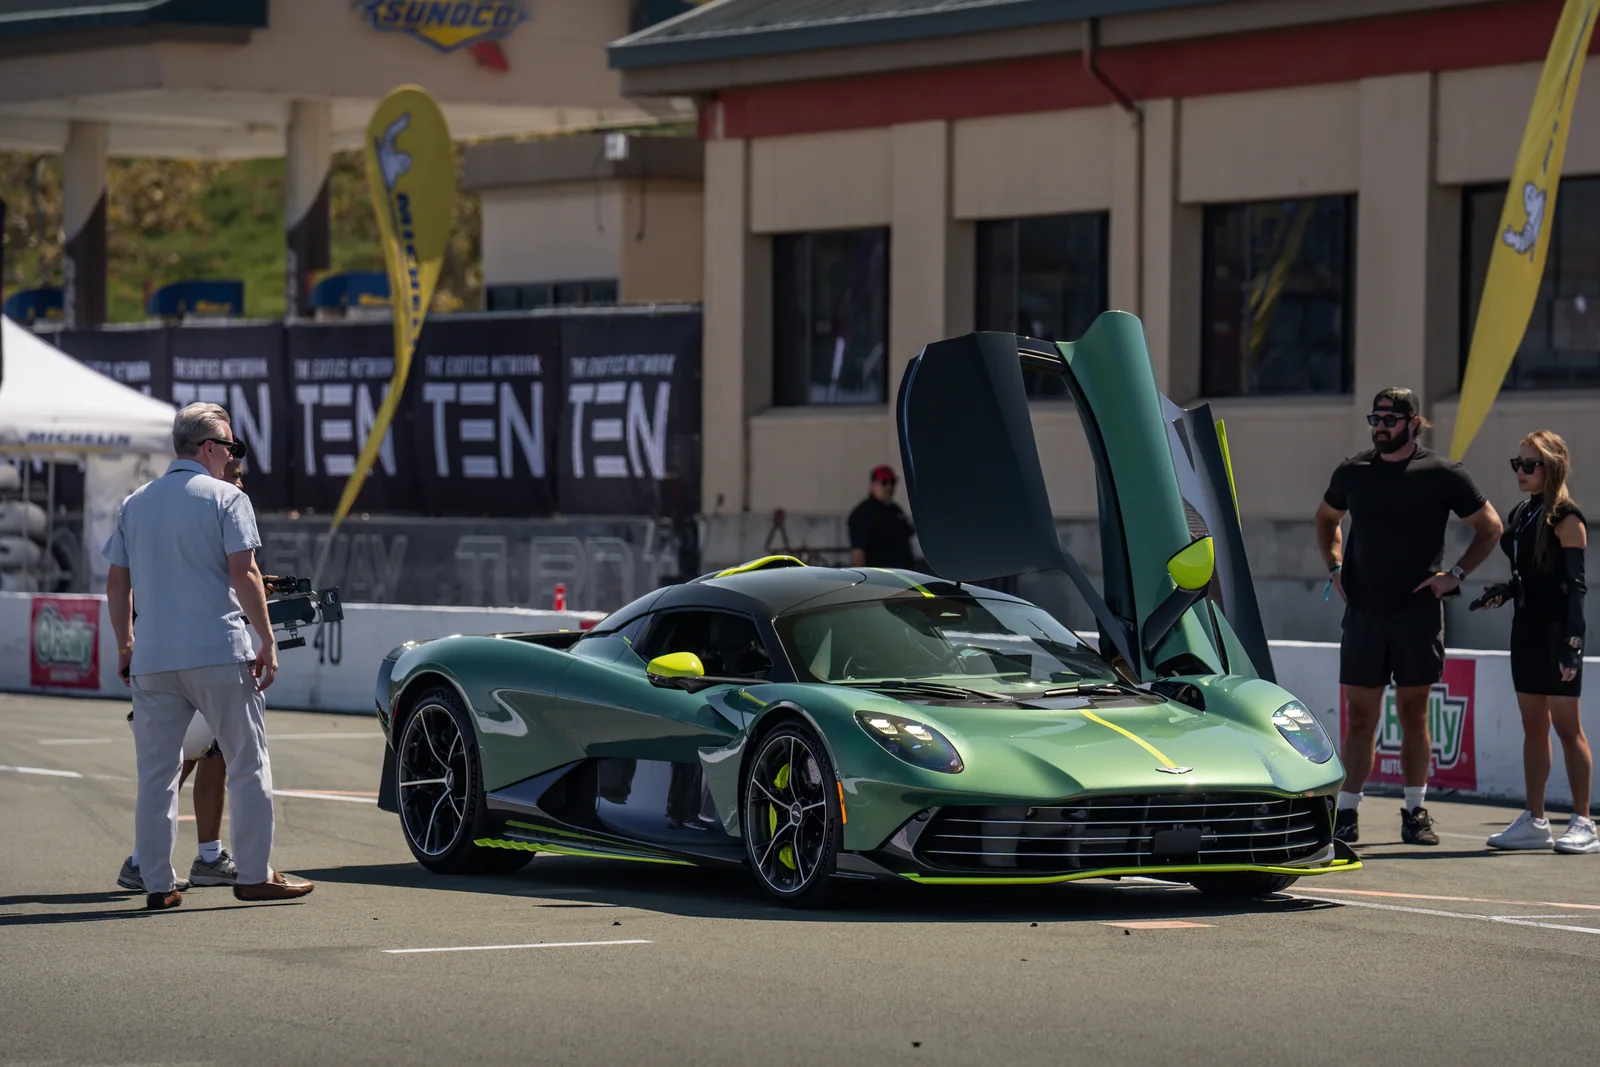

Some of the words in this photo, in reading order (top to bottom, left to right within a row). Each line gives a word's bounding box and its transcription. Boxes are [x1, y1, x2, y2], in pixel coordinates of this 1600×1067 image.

[383, 0, 516, 26] SUNOCO
[27, 431, 132, 446] MICHELIN
[296, 383, 397, 476] TEN
[422, 381, 546, 478] TEN
[568, 381, 671, 480] TEN
